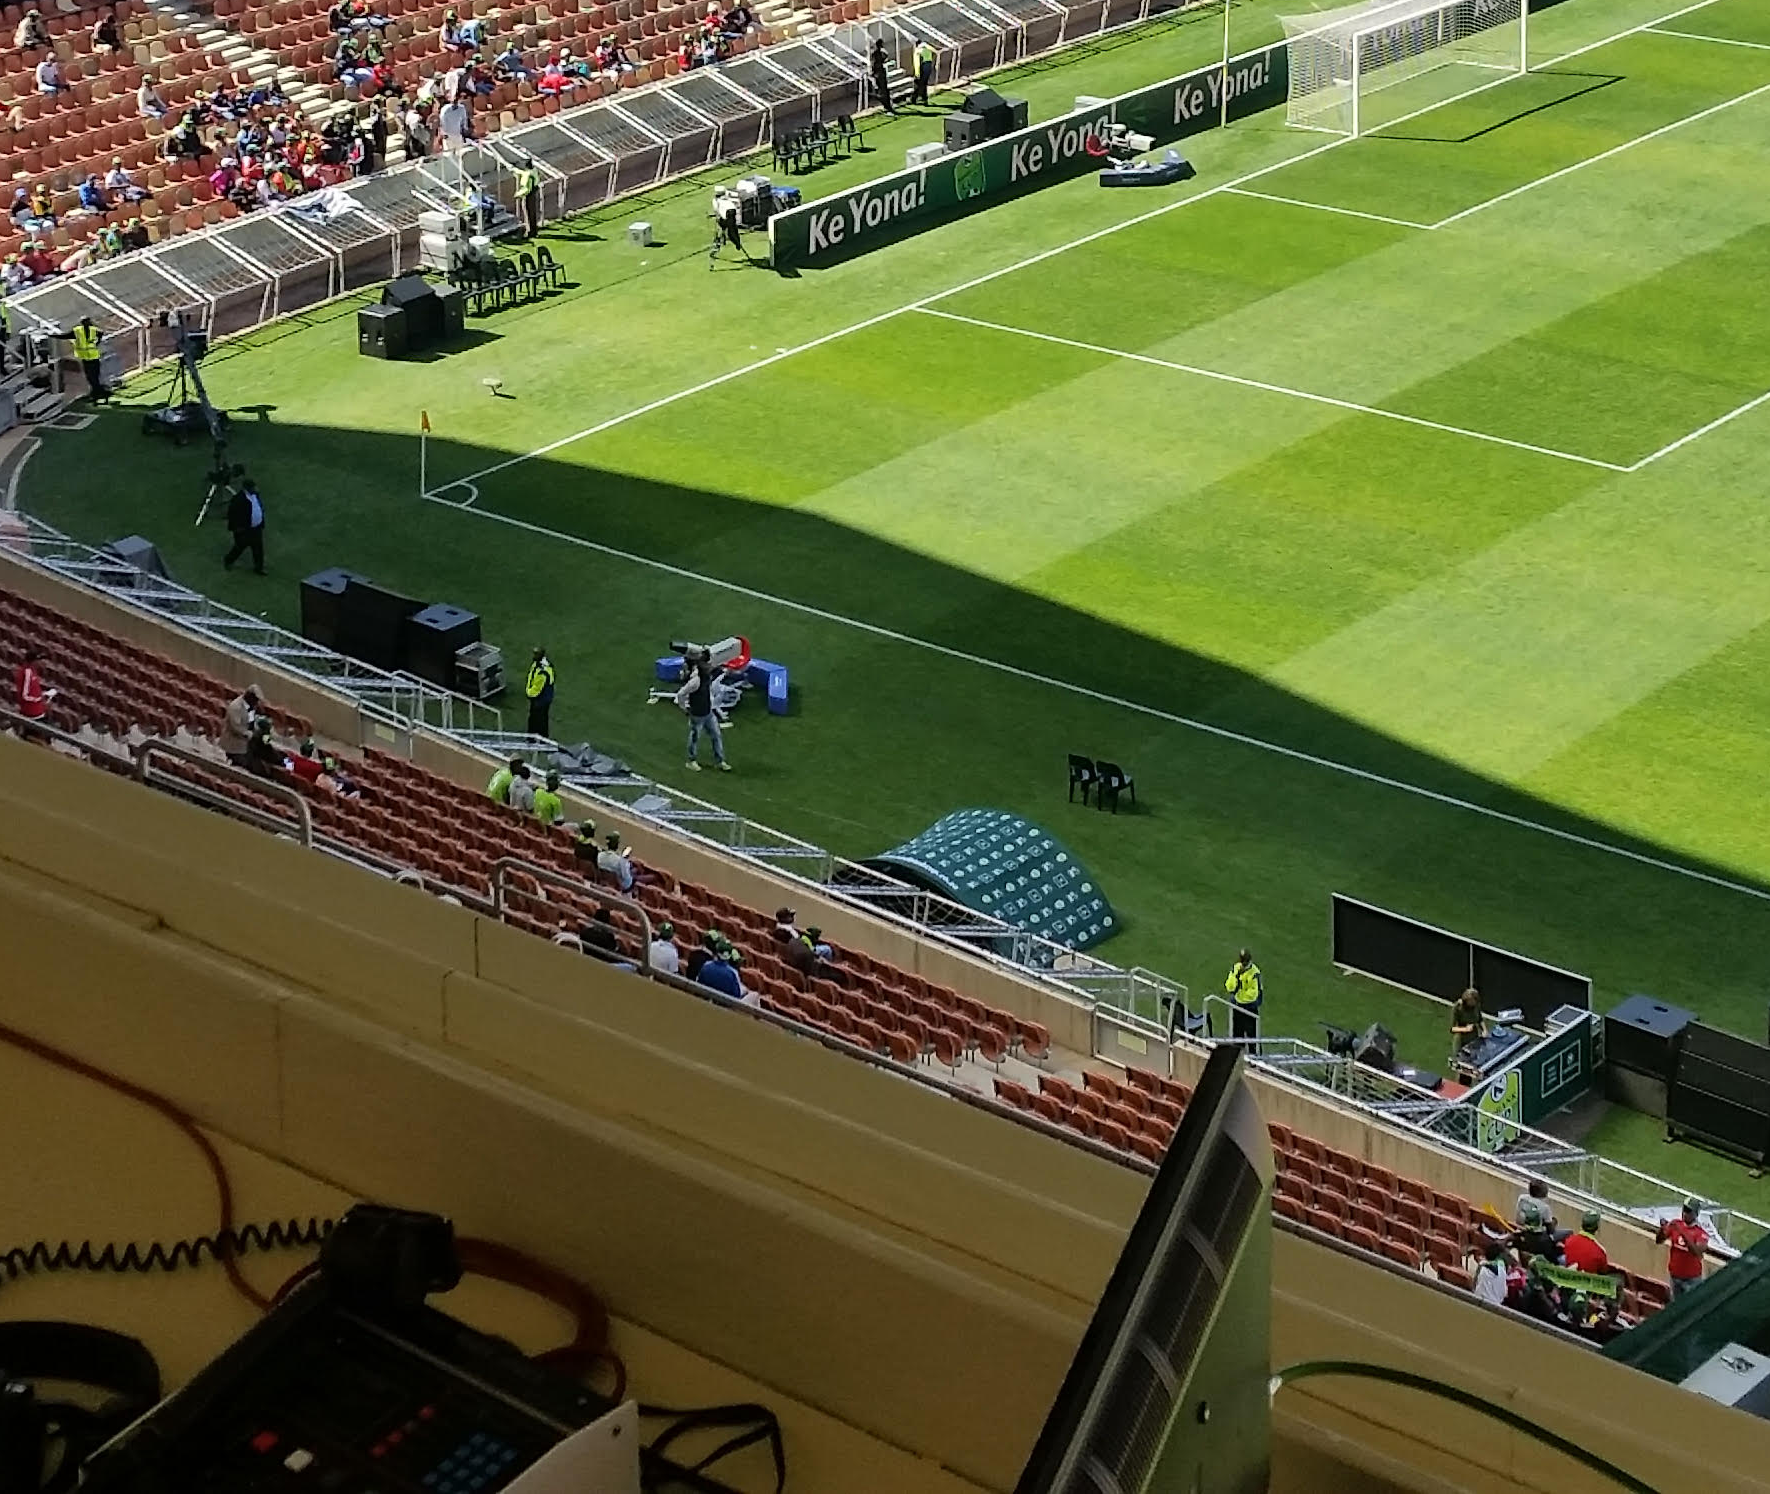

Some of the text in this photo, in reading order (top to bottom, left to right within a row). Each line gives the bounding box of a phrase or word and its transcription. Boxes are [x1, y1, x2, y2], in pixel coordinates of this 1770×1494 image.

[1174, 50, 1271, 126] Ke Yona!
[1011, 103, 1117, 183] Ke Yona!
[809, 172, 928, 256] Ke Yona!
